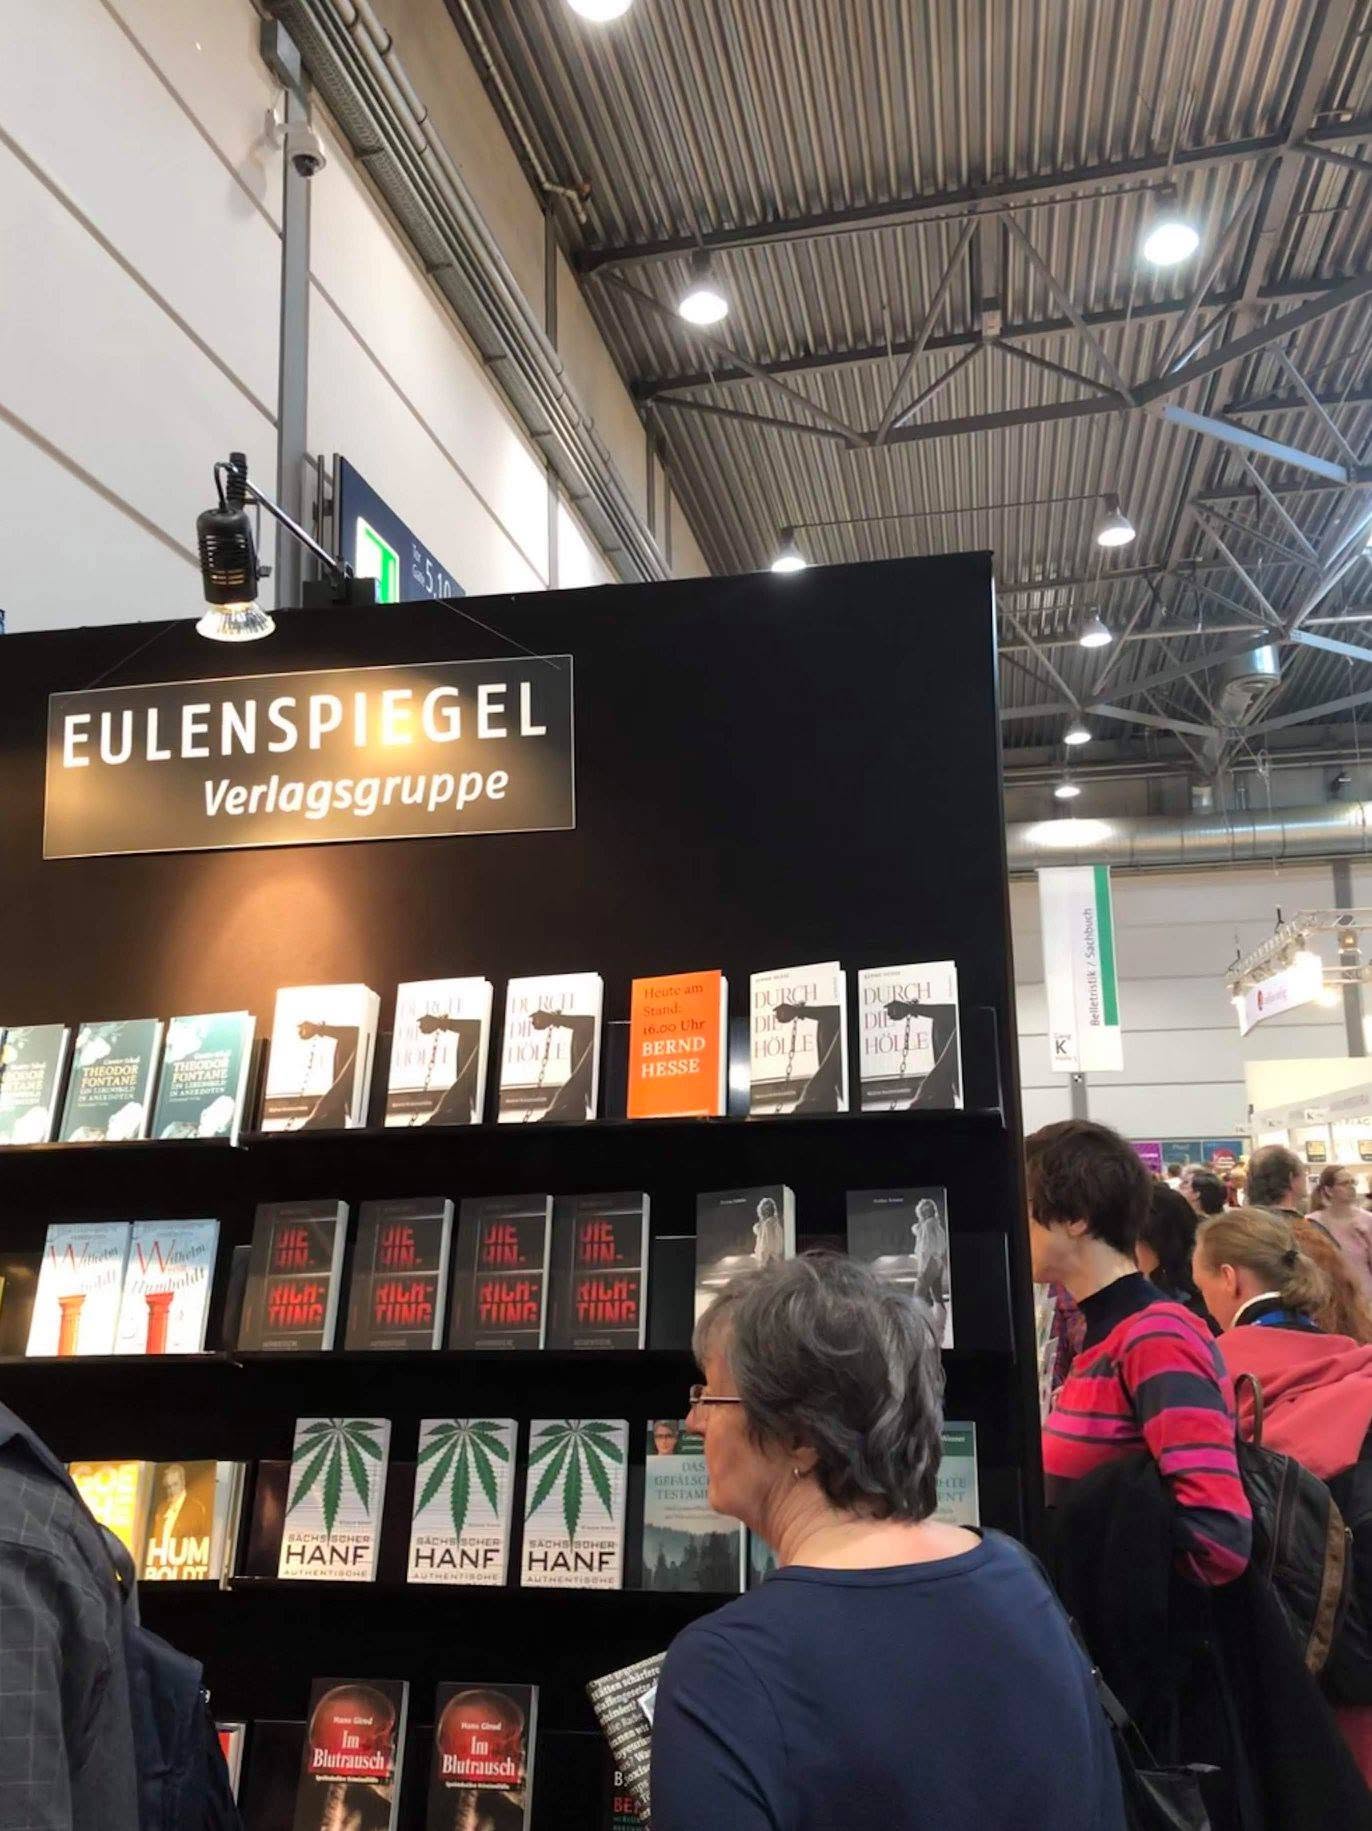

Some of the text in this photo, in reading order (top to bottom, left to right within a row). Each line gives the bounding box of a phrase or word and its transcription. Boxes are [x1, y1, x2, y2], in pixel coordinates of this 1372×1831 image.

[62, 681, 547, 768] EULENSPIEGEL
[204, 769, 509, 818] Verlagsgruppe
[1083, 908, 1096, 959] Sachbuch
[644, 984, 704, 999] Heute am
[755, 983, 817, 1009] DURCH
[864, 981, 932, 1005] DURCH
[1086, 971, 1100, 1026] Belletristik
[512, 992, 575, 1013] DURCH
[643, 1004, 682, 1017] Stand:
[643, 1019, 706, 1036] 16.00 Uhr
[865, 1010, 892, 1030] DIE
[508, 1041, 568, 1064] HÖLE
[642, 1036, 707, 1057] BERND
[1055, 1039, 1067, 1055] K
[83, 1065, 139, 1078] THEODOR
[173, 1059, 230, 1072] THEODOR
[641, 1058, 701, 1079] HESSE
[80, 1076, 136, 1088] FONTANE
[172, 1070, 228, 1083] FONTANE
[136, 1238, 206, 1275] Wilhelm
[682, 1461, 706, 1472] DAS
[655, 1473, 710, 1486] GEFÄLSC
[657, 1488, 709, 1501] TESTAM
[287, 1533, 370, 1543] SÄCHSSCHER
[415, 1536, 501, 1546] SÄCHSSCHER
[529, 1539, 616, 1549] SÄCHSSCHER
[146, 1536, 210, 1566] HUM
[285, 1544, 370, 1566] HANF
[414, 1547, 500, 1569] HANF
[528, 1550, 615, 1572] HANF
[284, 1569, 368, 1577] AUTHENTISCHE
[412, 1572, 499, 1581] AUTHENTISCHE
[527, 1575, 615, 1584] AUTHENTISCHE
[342, 1729, 360, 1749] Im
[470, 1735, 489, 1755] Im
[312, 1747, 385, 1770] Blutrausch
[442, 1753, 515, 1776] Blutrausch
